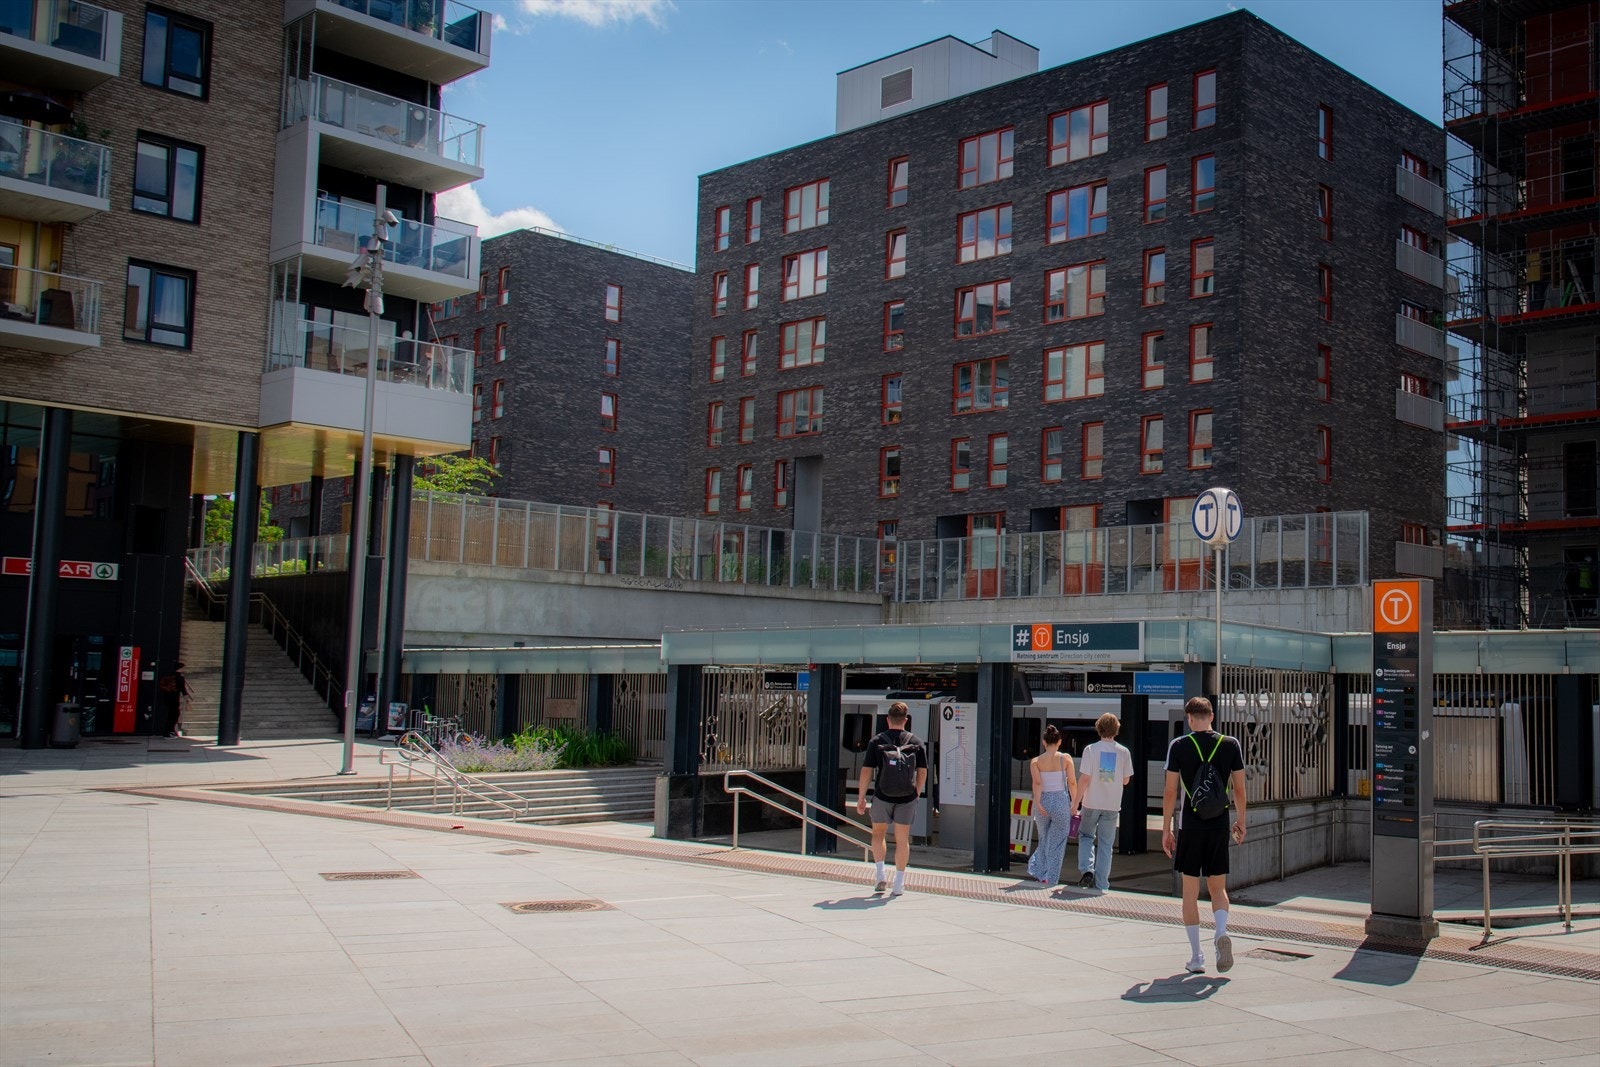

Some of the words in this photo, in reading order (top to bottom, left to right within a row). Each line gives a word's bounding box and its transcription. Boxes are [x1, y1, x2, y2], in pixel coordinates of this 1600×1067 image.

[1199, 503, 1213, 532] T
[1227, 503, 1238, 532] T
[25, 561, 90, 575] SAR
[1389, 598, 1403, 620] T
[1056, 629, 1090, 647] Ensjø
[1386, 642, 1406, 652] Ensjø
[1083, 653, 1093, 661] city
[121, 660, 130, 692] SPAR
